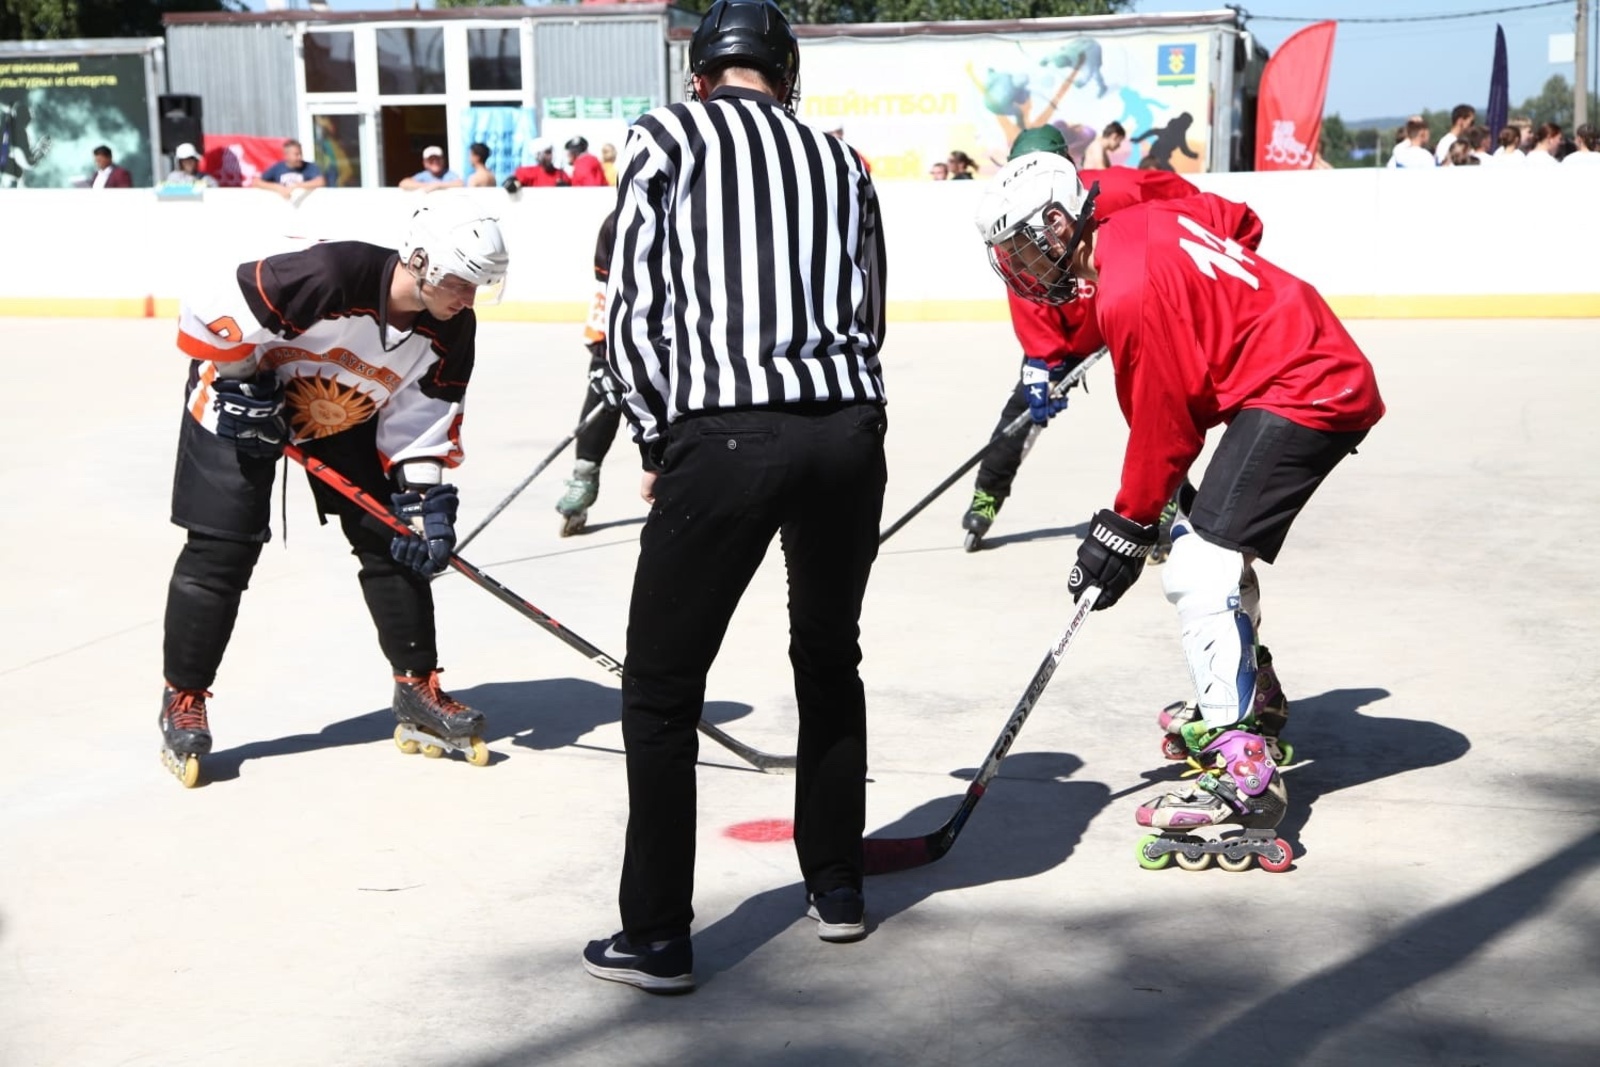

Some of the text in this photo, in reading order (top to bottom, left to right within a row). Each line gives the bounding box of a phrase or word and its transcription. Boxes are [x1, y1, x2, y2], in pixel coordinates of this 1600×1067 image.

[0, 75, 117, 88] льтуры и спорта
[806, 89, 957, 116] ПЕЙНТБОЛ
